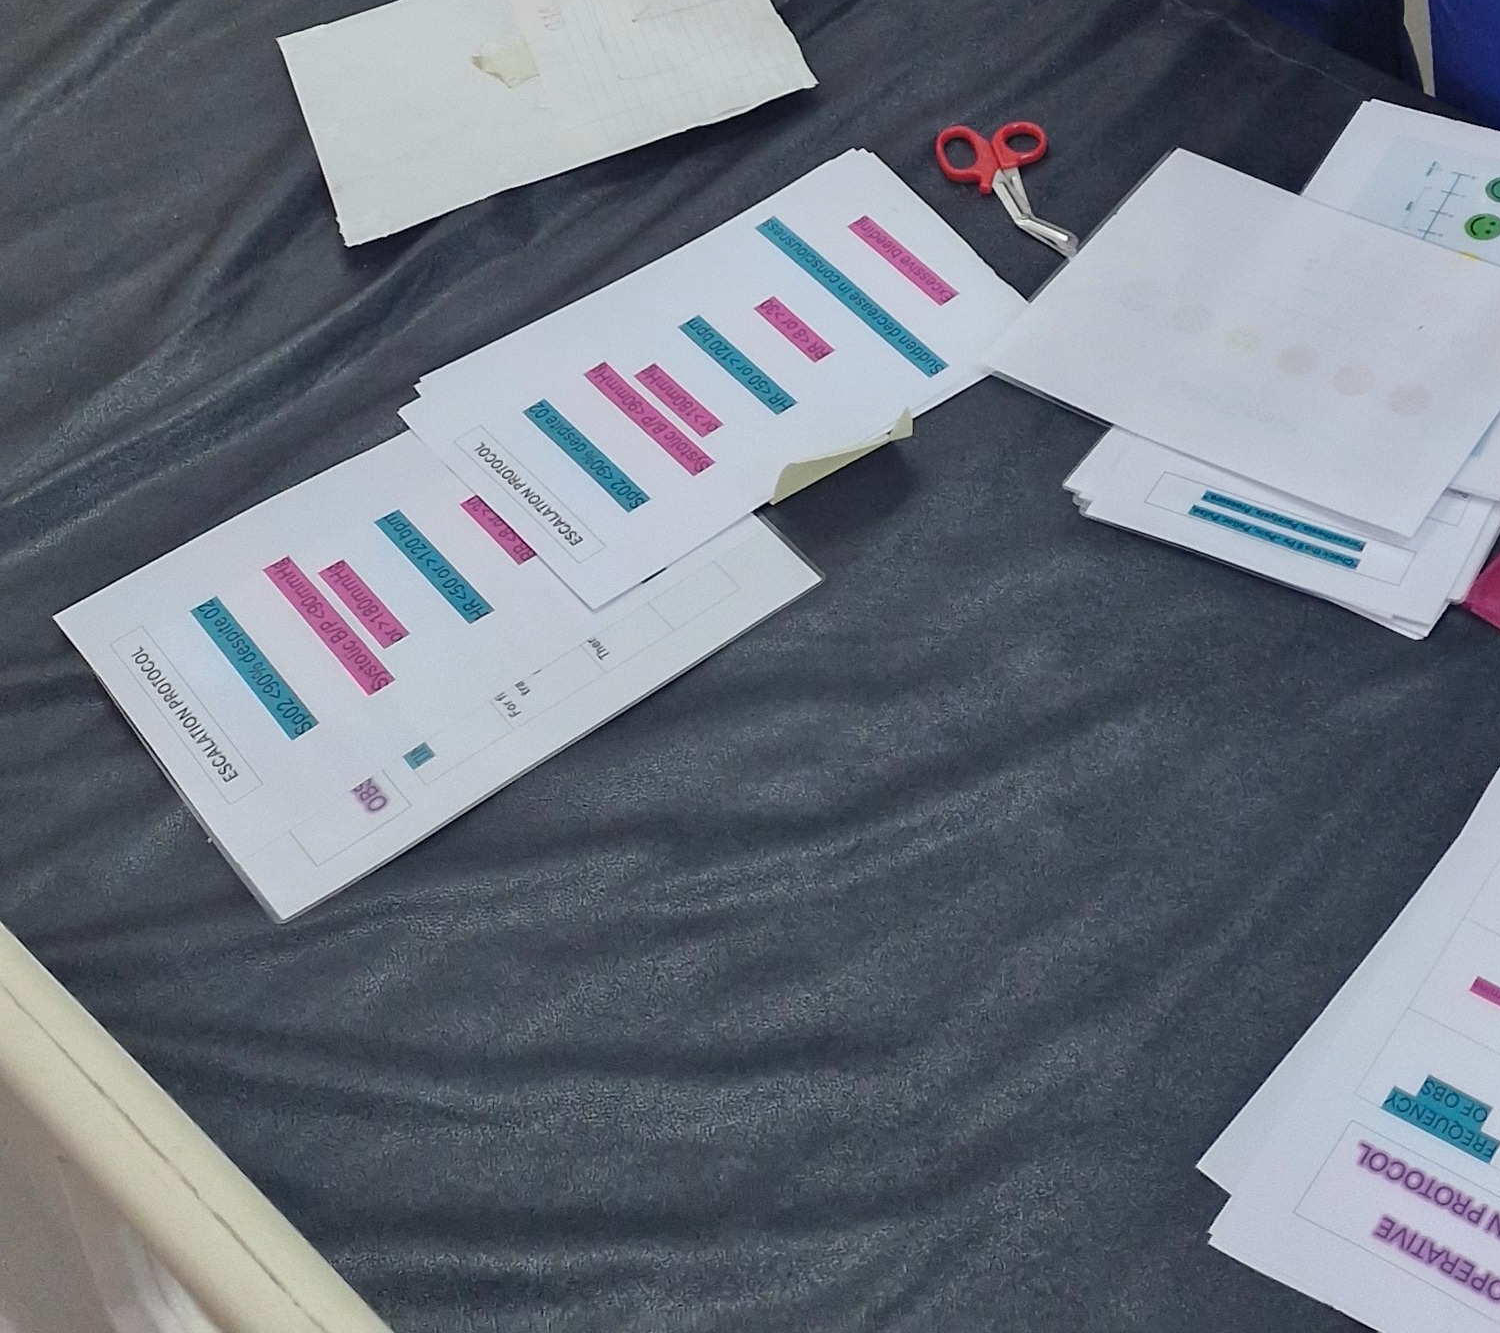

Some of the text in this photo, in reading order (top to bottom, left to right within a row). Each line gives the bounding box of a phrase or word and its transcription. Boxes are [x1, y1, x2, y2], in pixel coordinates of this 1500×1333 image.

[850, 214, 955, 304] Excessive bleeding
[757, 297, 830, 360] RR <8 or >30
[759, 217, 945, 376] Sudden decrease in consciousness
[684, 316, 794, 411] HR <50 or >120 bpm
[541, 412, 590, 455] despite
[639, 410, 669, 435] B/P
[661, 429, 713, 473] Systolic
[702, 416, 720, 431] or
[473, 441, 584, 546] ESCALATION PROTOCOL
[579, 449, 616, 482] <90%
[379, 510, 490, 620] HR <50 or >120 bpm
[269, 556, 392, 692] Systolic B/P <90mmHg
[322, 558, 405, 643] or >180mmHg
[207, 615, 259, 667] despite
[129, 645, 239, 783] ESCALATION PROTOCOL
[245, 662, 285, 702] <90%
[1383, 1089, 1499, 1159] FREQUENCY
[1419, 1078, 1490, 1125] OF OBS
[1350, 1140, 1488, 1226] PROTOCOL
